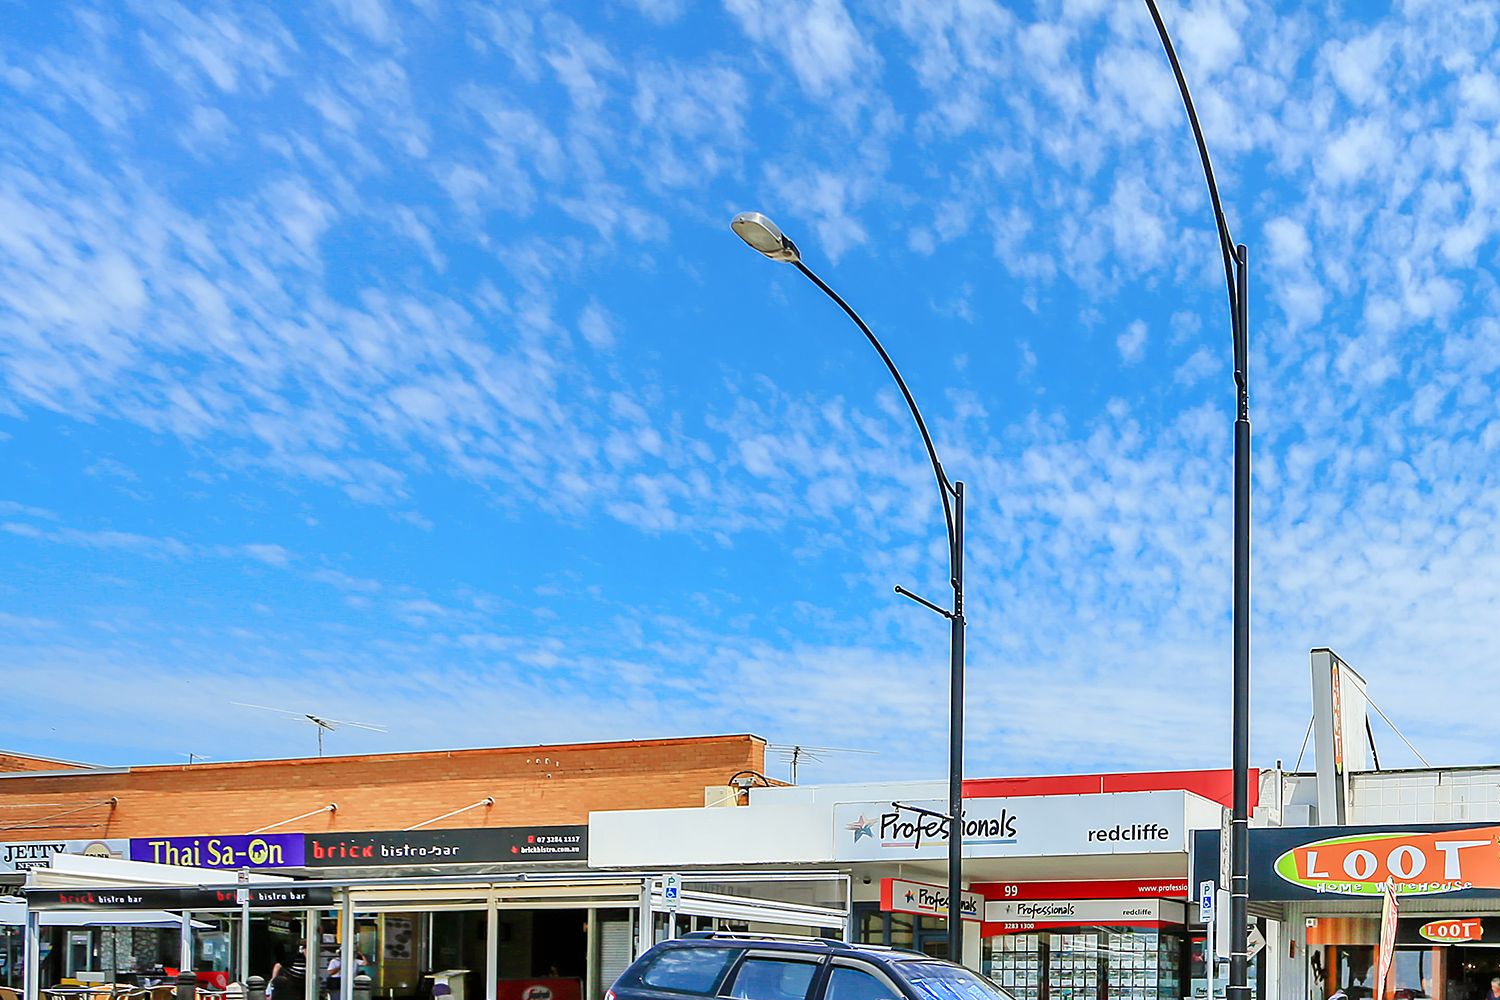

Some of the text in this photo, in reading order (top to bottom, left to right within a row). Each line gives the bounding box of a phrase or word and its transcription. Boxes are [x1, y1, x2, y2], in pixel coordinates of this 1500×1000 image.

[880, 808, 1017, 849] Profesionals
[1088, 824, 1169, 842] redcliffe
[4, 844, 66, 862] JETTY
[149, 838, 284, 866] Thai Sa-On
[313, 840, 375, 859] brick
[381, 844, 426, 857] bistro
[1307, 840, 1492, 880] LOOT
[290, 892, 306, 900] bar
[1004, 885, 1018, 897] 99
[1138, 885, 1188, 893] www.professio
[127, 895, 143, 903] bar
[919, 888, 976, 912] Profesnals
[1017, 903, 1075, 919] Professionals
[1428, 922, 1477, 937] LOOT
